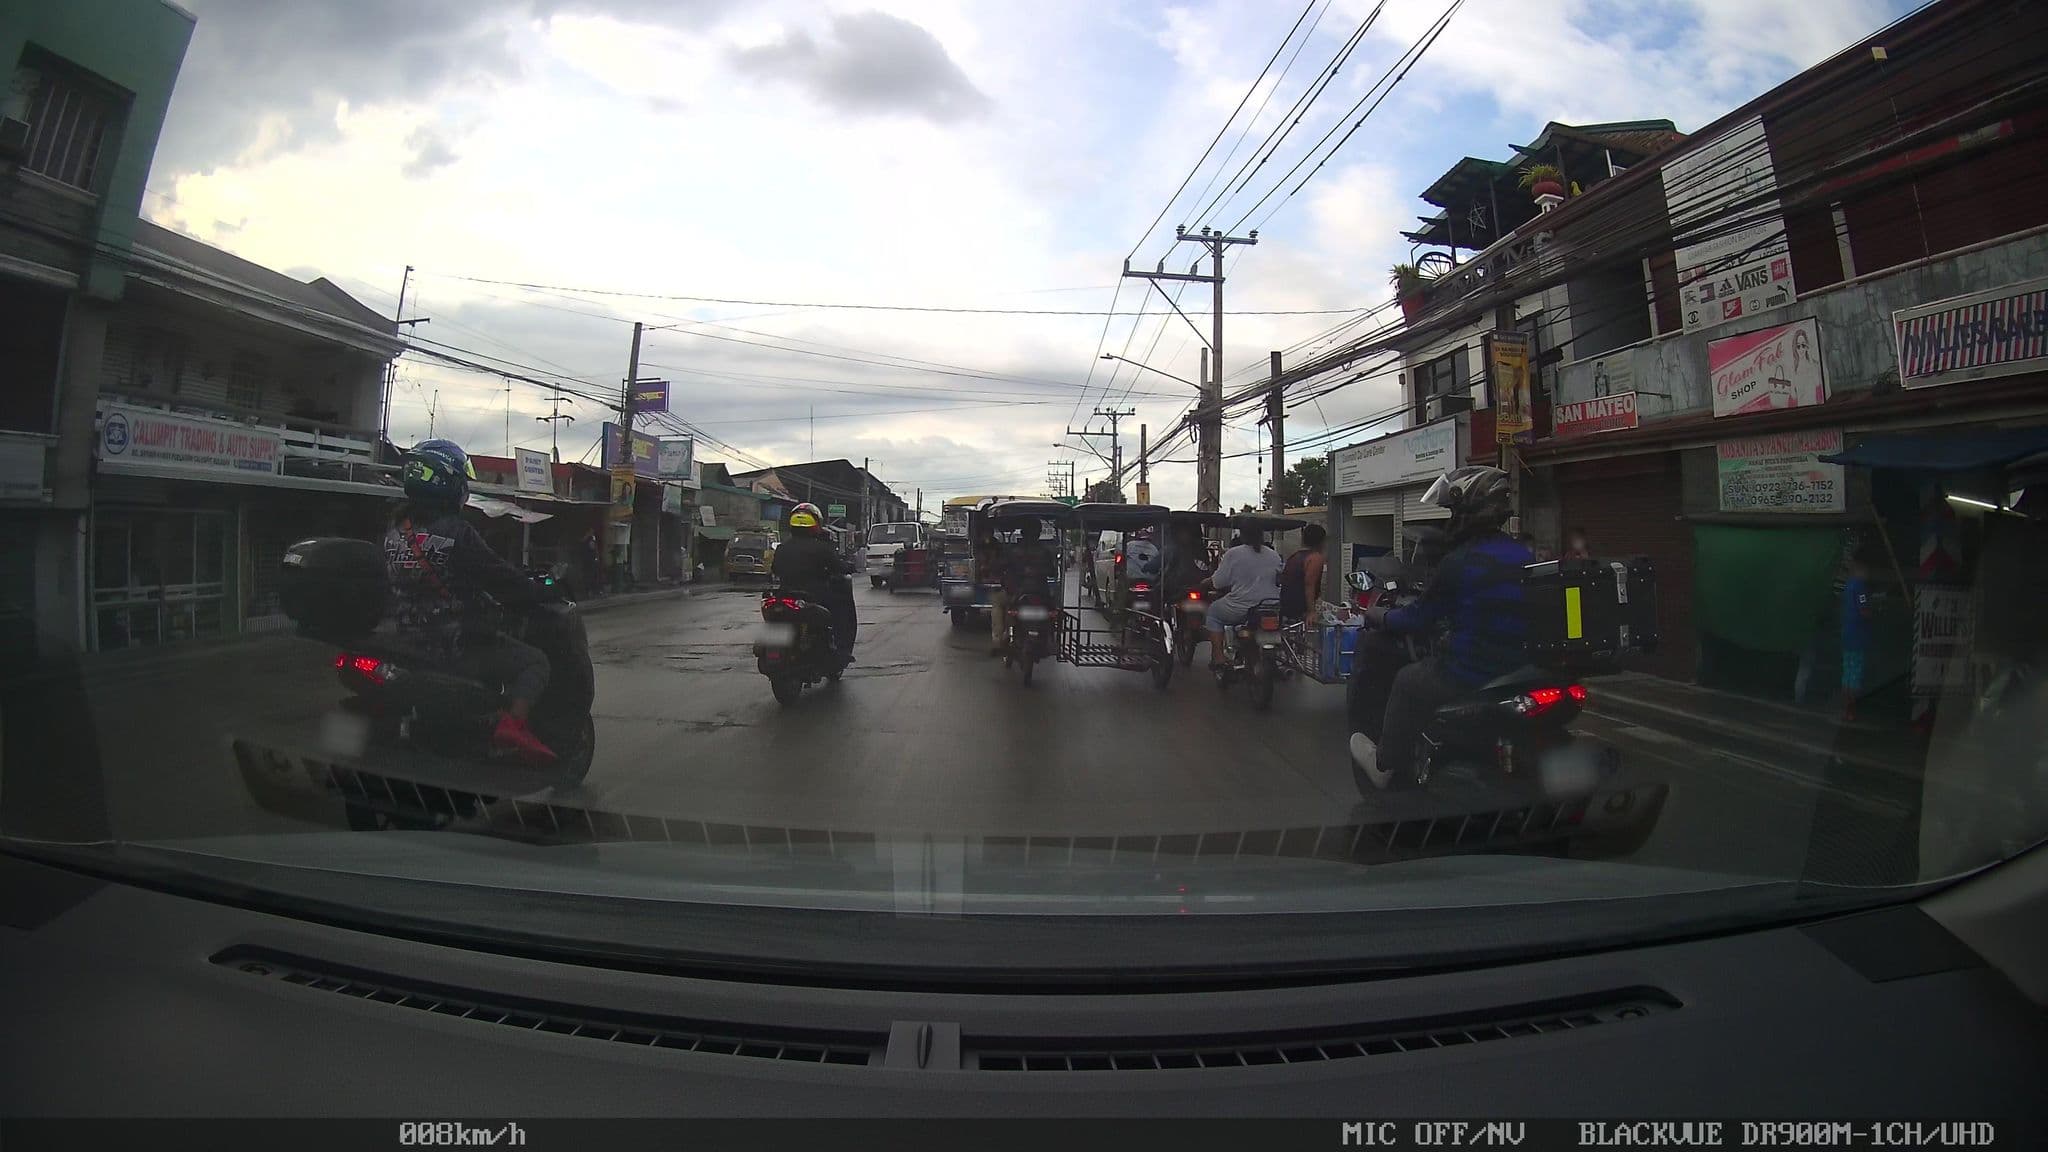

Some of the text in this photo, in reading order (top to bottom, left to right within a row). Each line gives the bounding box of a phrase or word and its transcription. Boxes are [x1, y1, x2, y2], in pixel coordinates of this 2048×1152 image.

[1735, 265, 1768, 291] VANS
[1731, 380, 1757, 400] SHOP
[1557, 395, 1634, 424] SAN MATEO
[180, 425, 217, 454] TRADING
[226, 432, 247, 458] AUTO
